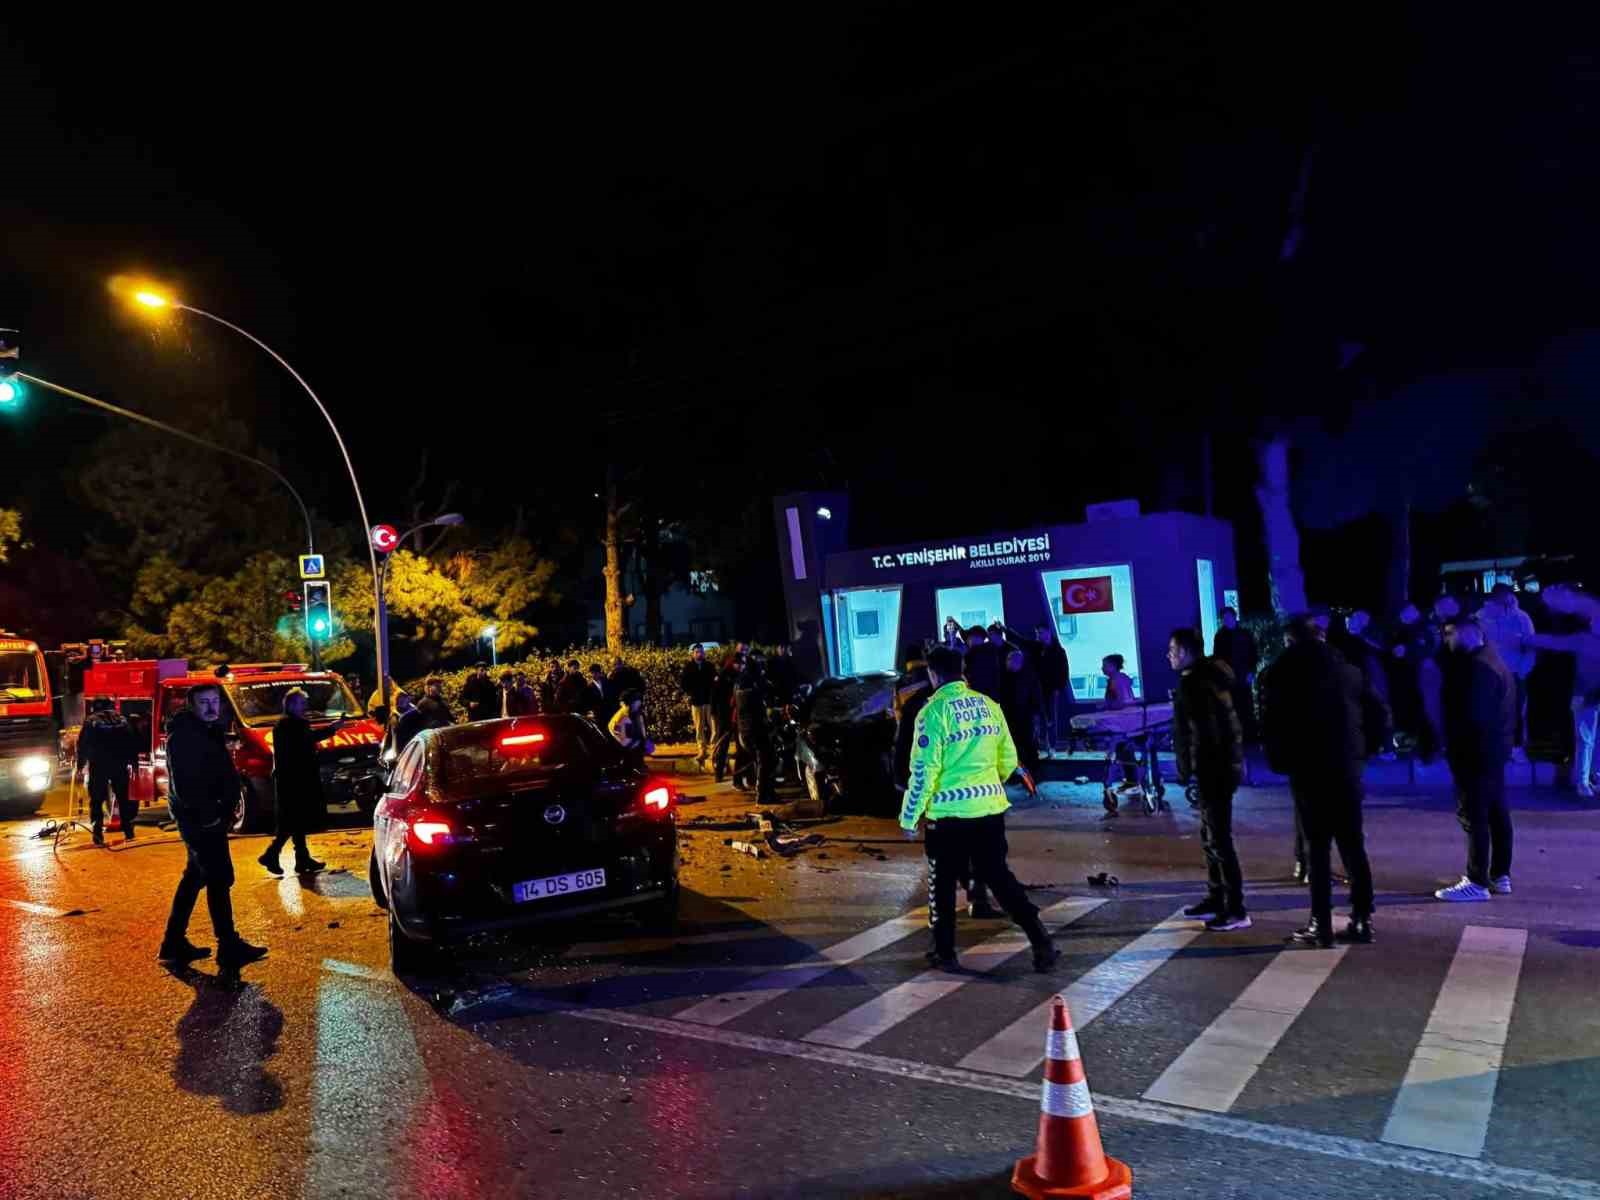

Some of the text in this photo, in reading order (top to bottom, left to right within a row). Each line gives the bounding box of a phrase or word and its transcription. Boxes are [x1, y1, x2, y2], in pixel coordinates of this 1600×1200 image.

[872, 533, 1050, 569] T.C. YENİŞEHİR BELEDİYESİ
[969, 552, 1050, 569] AKILLI DURAK 2019
[523, 871, 603, 898] 14 DS 605
